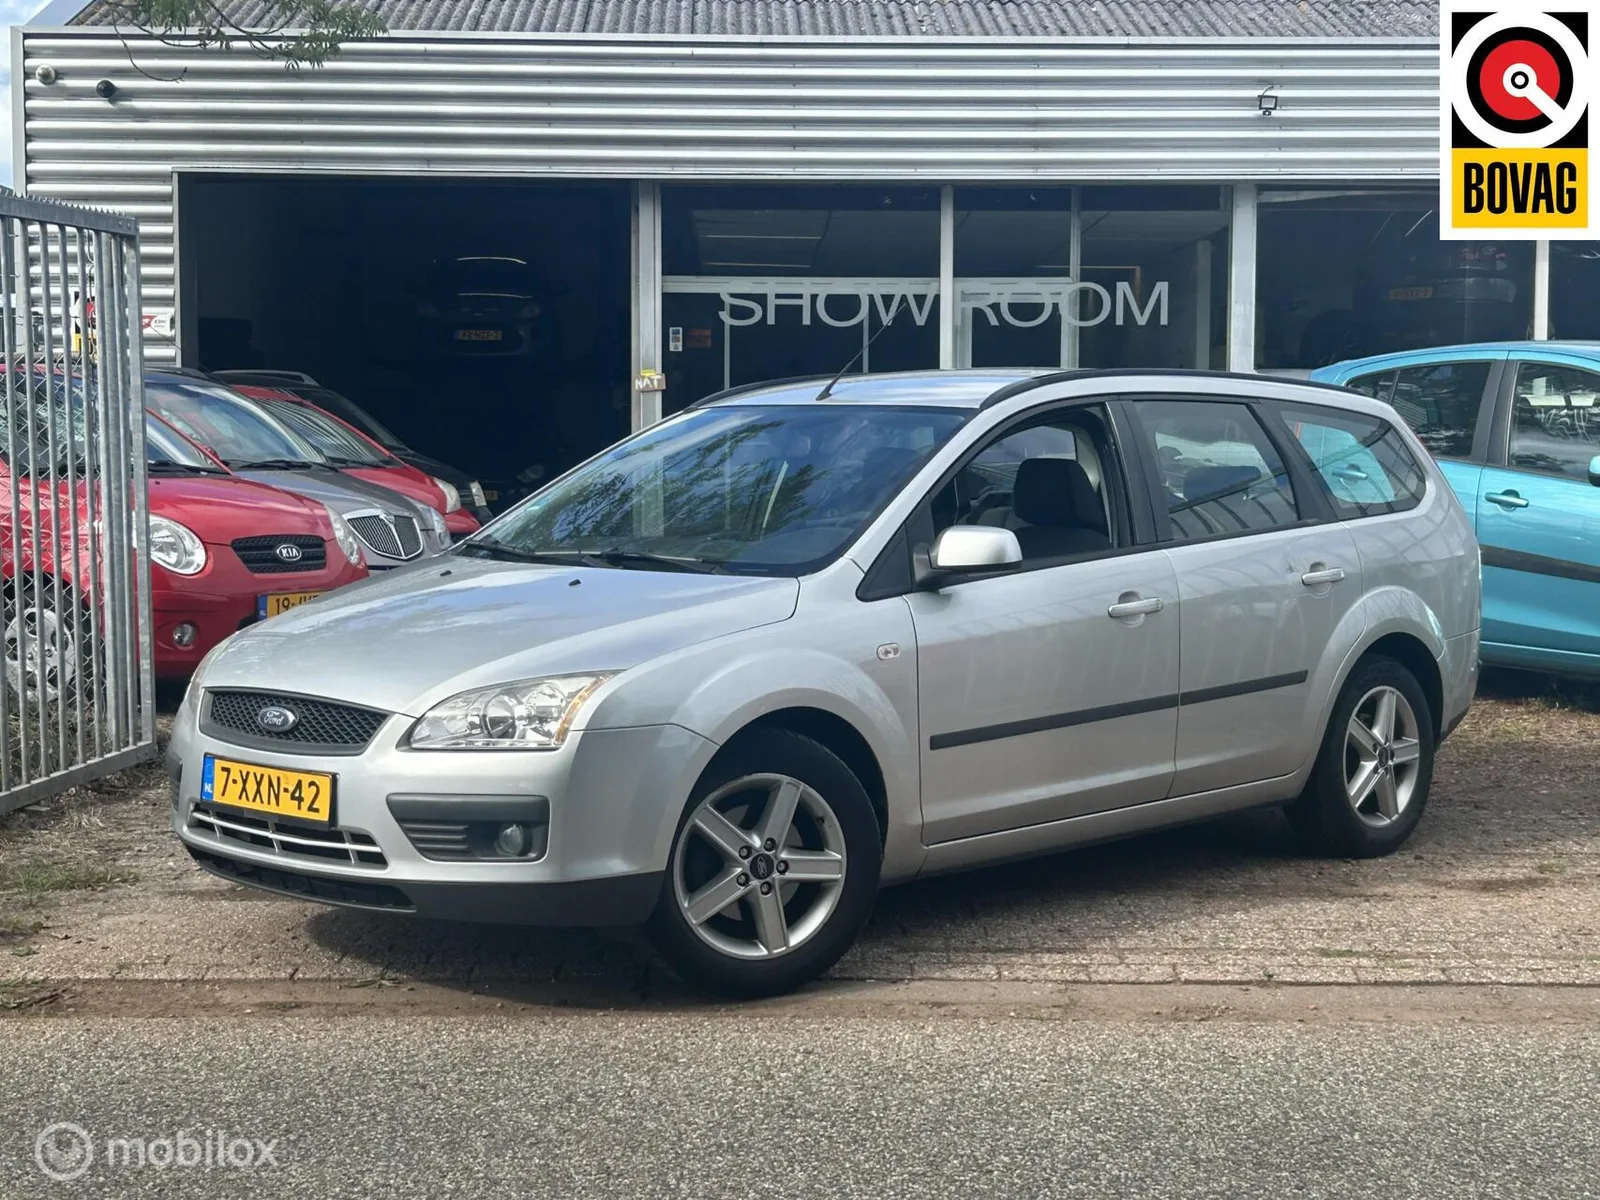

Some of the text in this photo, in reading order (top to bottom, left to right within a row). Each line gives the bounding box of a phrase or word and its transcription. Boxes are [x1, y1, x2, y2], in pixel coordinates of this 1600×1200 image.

[635, 374, 662, 389] NAT
[281, 547, 299, 558] KIA
[263, 710, 284, 726] Ford
[204, 782, 213, 793] NL
[220, 766, 320, 813] 7-XXN-42
